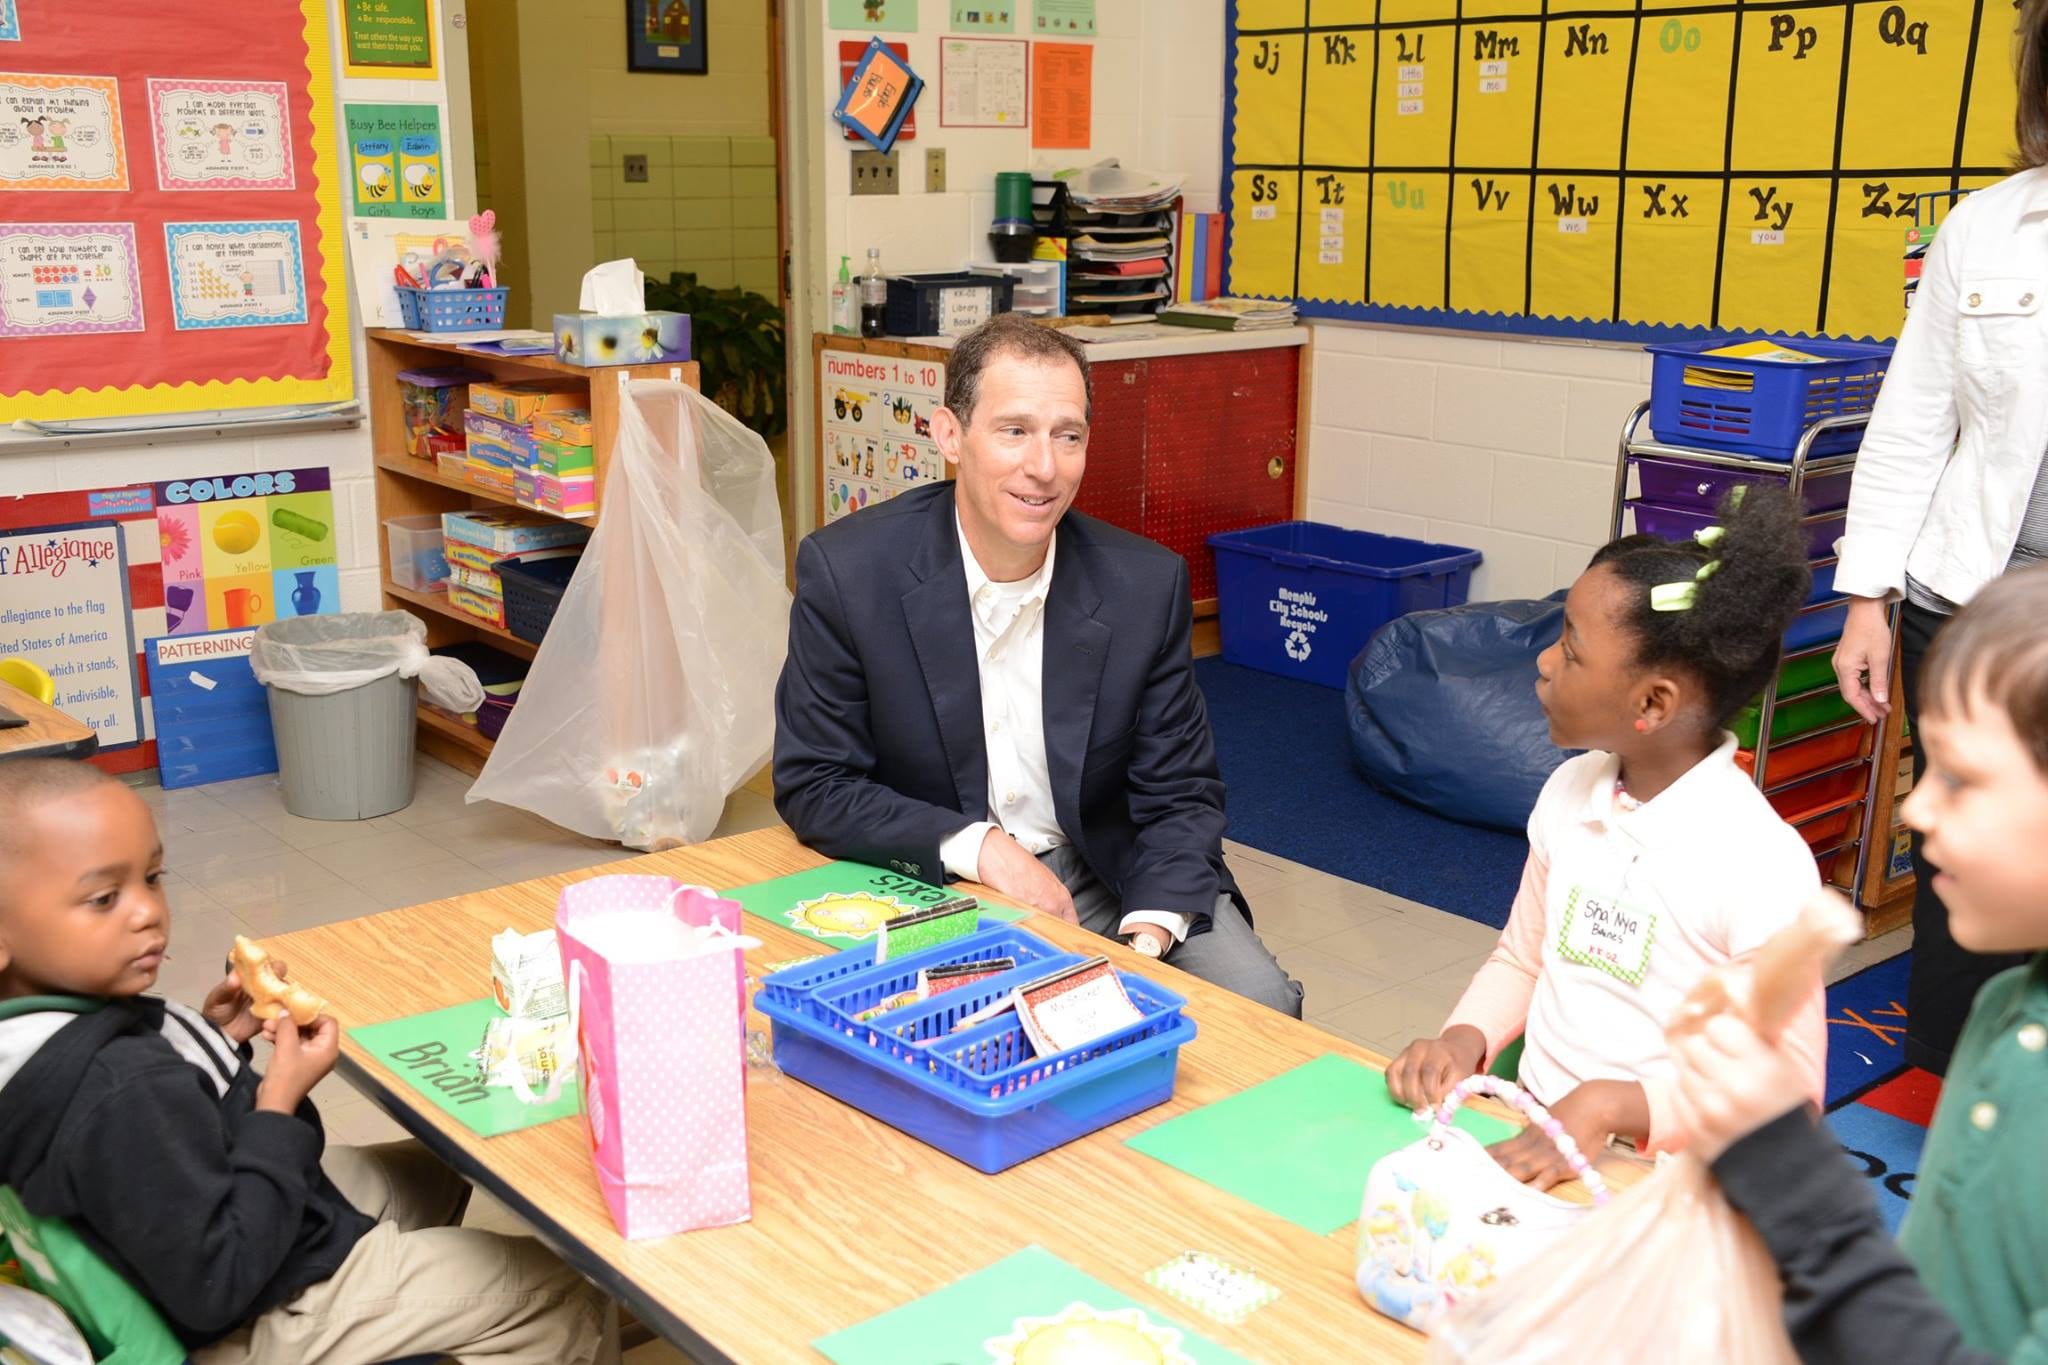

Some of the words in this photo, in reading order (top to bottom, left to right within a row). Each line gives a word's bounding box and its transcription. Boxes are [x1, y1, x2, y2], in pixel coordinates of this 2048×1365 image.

[354, 32, 369, 40] Treat
[370, 32, 387, 41] others
[388, 32, 398, 41] the
[412, 36, 424, 44] you
[1564, 24, 1609, 58] Nn
[1659, 18, 1702, 54] Oo
[1768, 13, 1818, 60] Pp
[1878, 5, 1929, 56] Qq
[1324, 35, 1356, 65] Kk
[1396, 34, 1426, 63] Ll
[1474, 30, 1520, 61] Mm
[1253, 41, 1280, 76] Jj
[1487, 65, 1499, 74] my
[1400, 102, 1418, 112] look
[350, 118, 374, 133] Busy
[378, 119, 396, 130] Bee
[399, 118, 436, 133] Helpers
[1251, 174, 1278, 203] Ss
[1316, 174, 1345, 206] Tt
[1387, 180, 1426, 210] Uu
[1471, 178, 1510, 212] Vv
[1548, 183, 1599, 216] Ww
[368, 205, 391, 217] Girls
[411, 205, 436, 218] Boys
[1643, 183, 1689, 219] Xx
[1748, 186, 1794, 231] Yy
[1862, 182, 1917, 220] Zz
[1565, 223, 1580, 232] we
[1758, 232, 1777, 244] you
[952, 304, 978, 315] Library
[828, 358, 886, 381] numbers
[892, 364, 898, 382] 1
[904, 371, 915, 384] to
[920, 368, 936, 387] 10
[884, 394, 890, 406] 2
[828, 432, 834, 444] 3
[884, 442, 890, 454] 4
[166, 472, 296, 504] COLORS
[829, 478, 835, 492] 5
[12, 537, 115, 578] Allegiance
[234, 562, 270, 574] Yellow
[300, 556, 334, 567] Green
[180, 570, 202, 581] Pink
[1278, 588, 1316, 606] Memphis
[1, 608, 52, 624] allegiance
[54, 606, 64, 618] to
[68, 602, 82, 616] the
[86, 600, 105, 614] flag
[1270, 600, 1289, 618] City
[1290, 604, 1328, 623] Schools
[1280, 616, 1316, 633] Recycle
[22, 637, 53, 652] States
[56, 634, 66, 647] of
[68, 630, 108, 646] America
[160, 636, 252, 660] PATTERNING
[48, 662, 75, 678] which
[77, 662, 84, 674] it
[86, 658, 119, 673] stands,
[67, 686, 119, 705] indivisible,
[86, 716, 101, 730] for
[104, 714, 119, 728] all.
[389, 1040, 492, 1106] Brian
